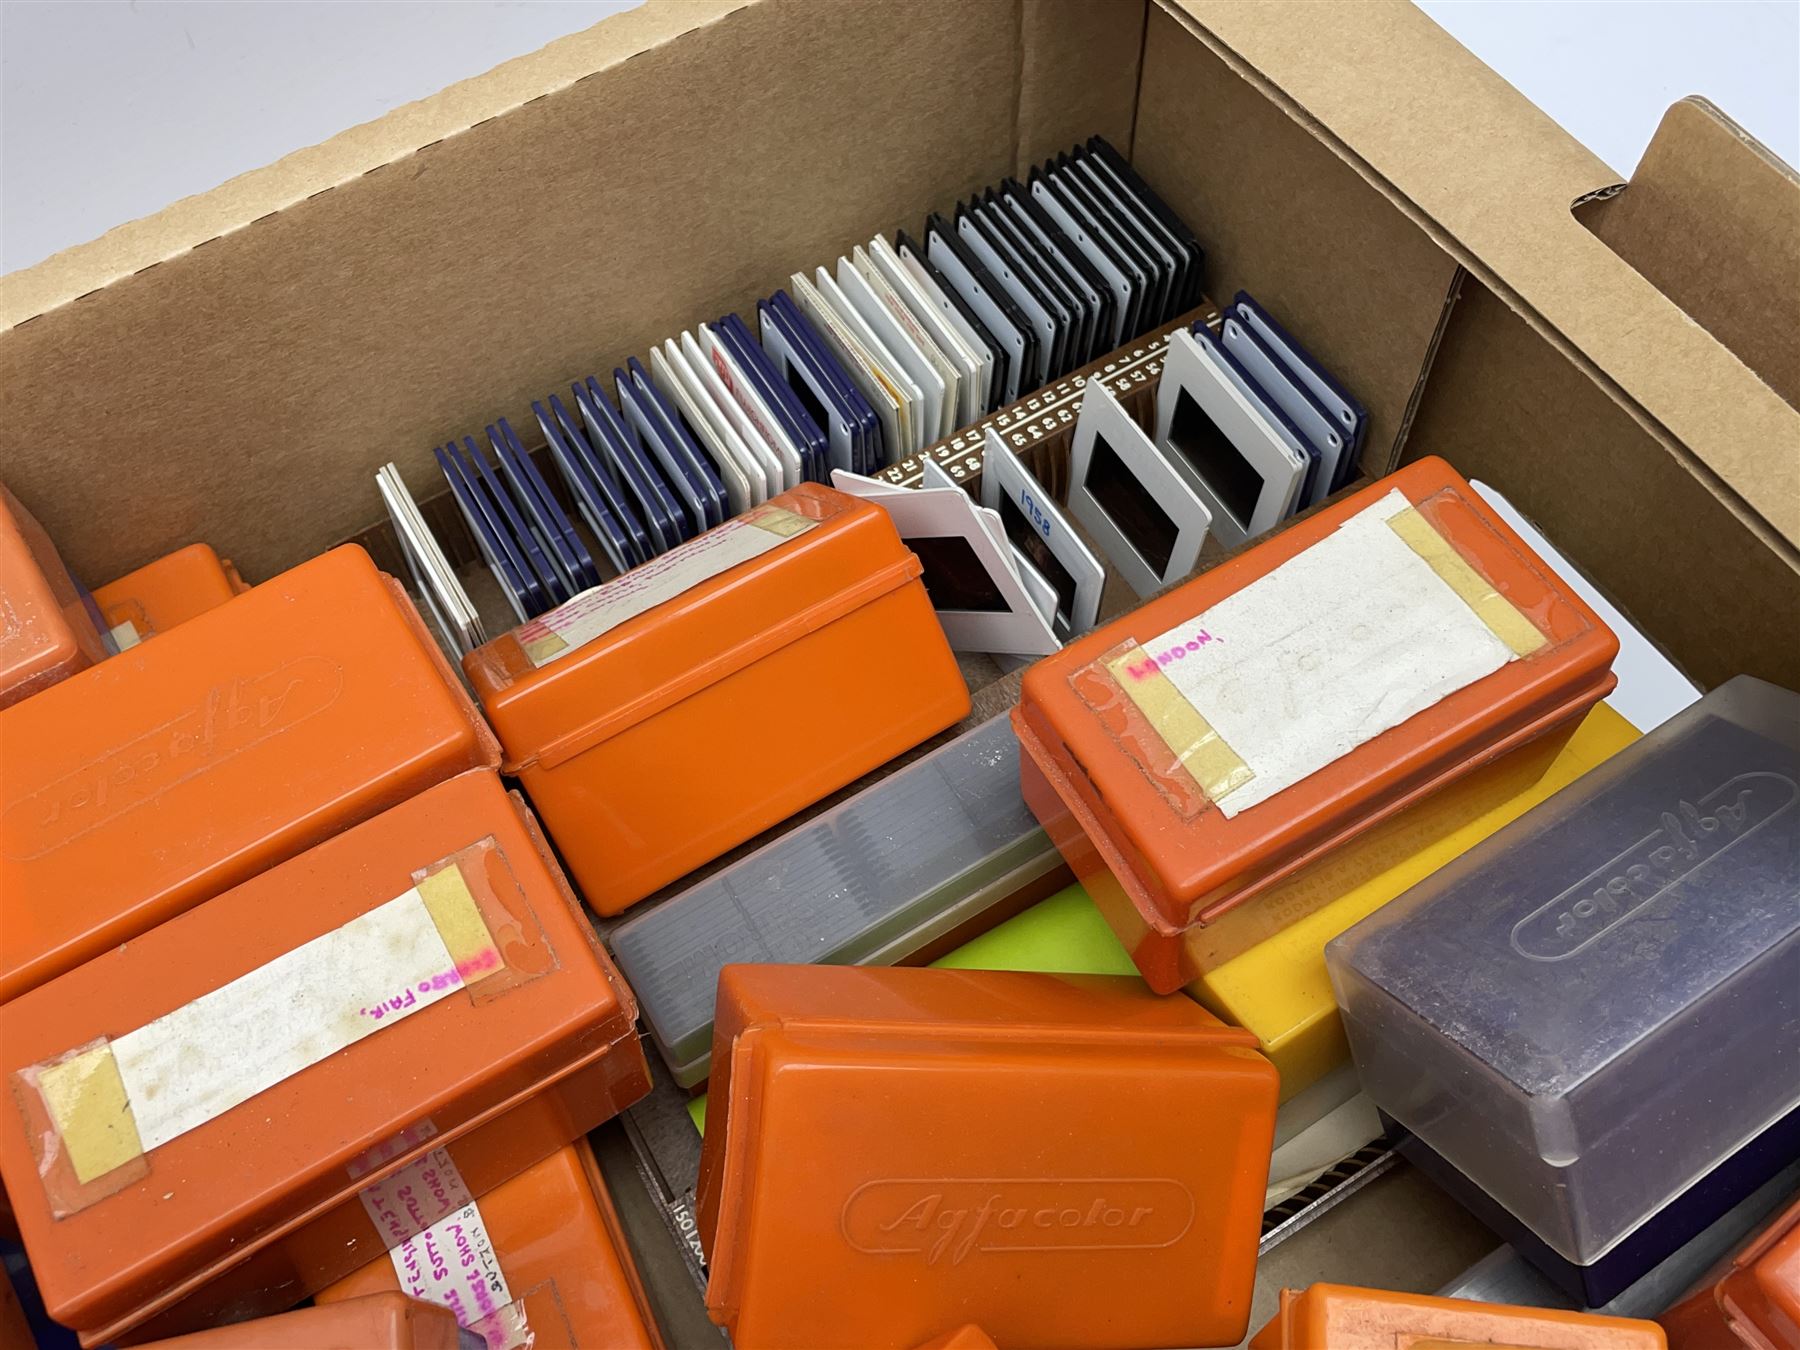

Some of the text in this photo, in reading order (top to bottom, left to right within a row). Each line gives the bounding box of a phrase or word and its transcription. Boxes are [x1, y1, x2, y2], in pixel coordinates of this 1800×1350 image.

[1147, 341, 1160, 350] 5
[1118, 355, 1131, 364] 7
[1132, 349, 1145, 358] 6
[1104, 363, 1117, 373] 8
[1145, 362, 1161, 375] 56
[1071, 375, 1086, 388] 10
[1130, 370, 1147, 382] 57
[1056, 383, 1071, 394] 11
[1115, 378, 1131, 391] 58
[1041, 390, 1056, 403] 12
[1026, 398, 1041, 410] 13
[1011, 406, 1027, 420] 14
[1057, 409, 1073, 423] 62
[996, 414, 1011, 426] 15
[1041, 417, 1057, 430] 63
[965, 429, 981, 441] 17
[1026, 425, 1043, 440] 64
[950, 437, 966, 450] 18
[1011, 433, 1027, 446] 65
[935, 445, 950, 457] 19
[901, 459, 918, 472] 21
[965, 458, 981, 471] 68
[886, 467, 903, 482] 22
[950, 465, 966, 478] 69
[1019, 489, 1051, 537] 1958
[40, 678, 304, 827] Agfacolor
[1556, 789, 1753, 938] Agfacolor
[359, 988, 416, 1019] FAIR,
[879, 1194, 1153, 1266] Agfacolor
[424, 1231, 449, 1281] SUTTO
